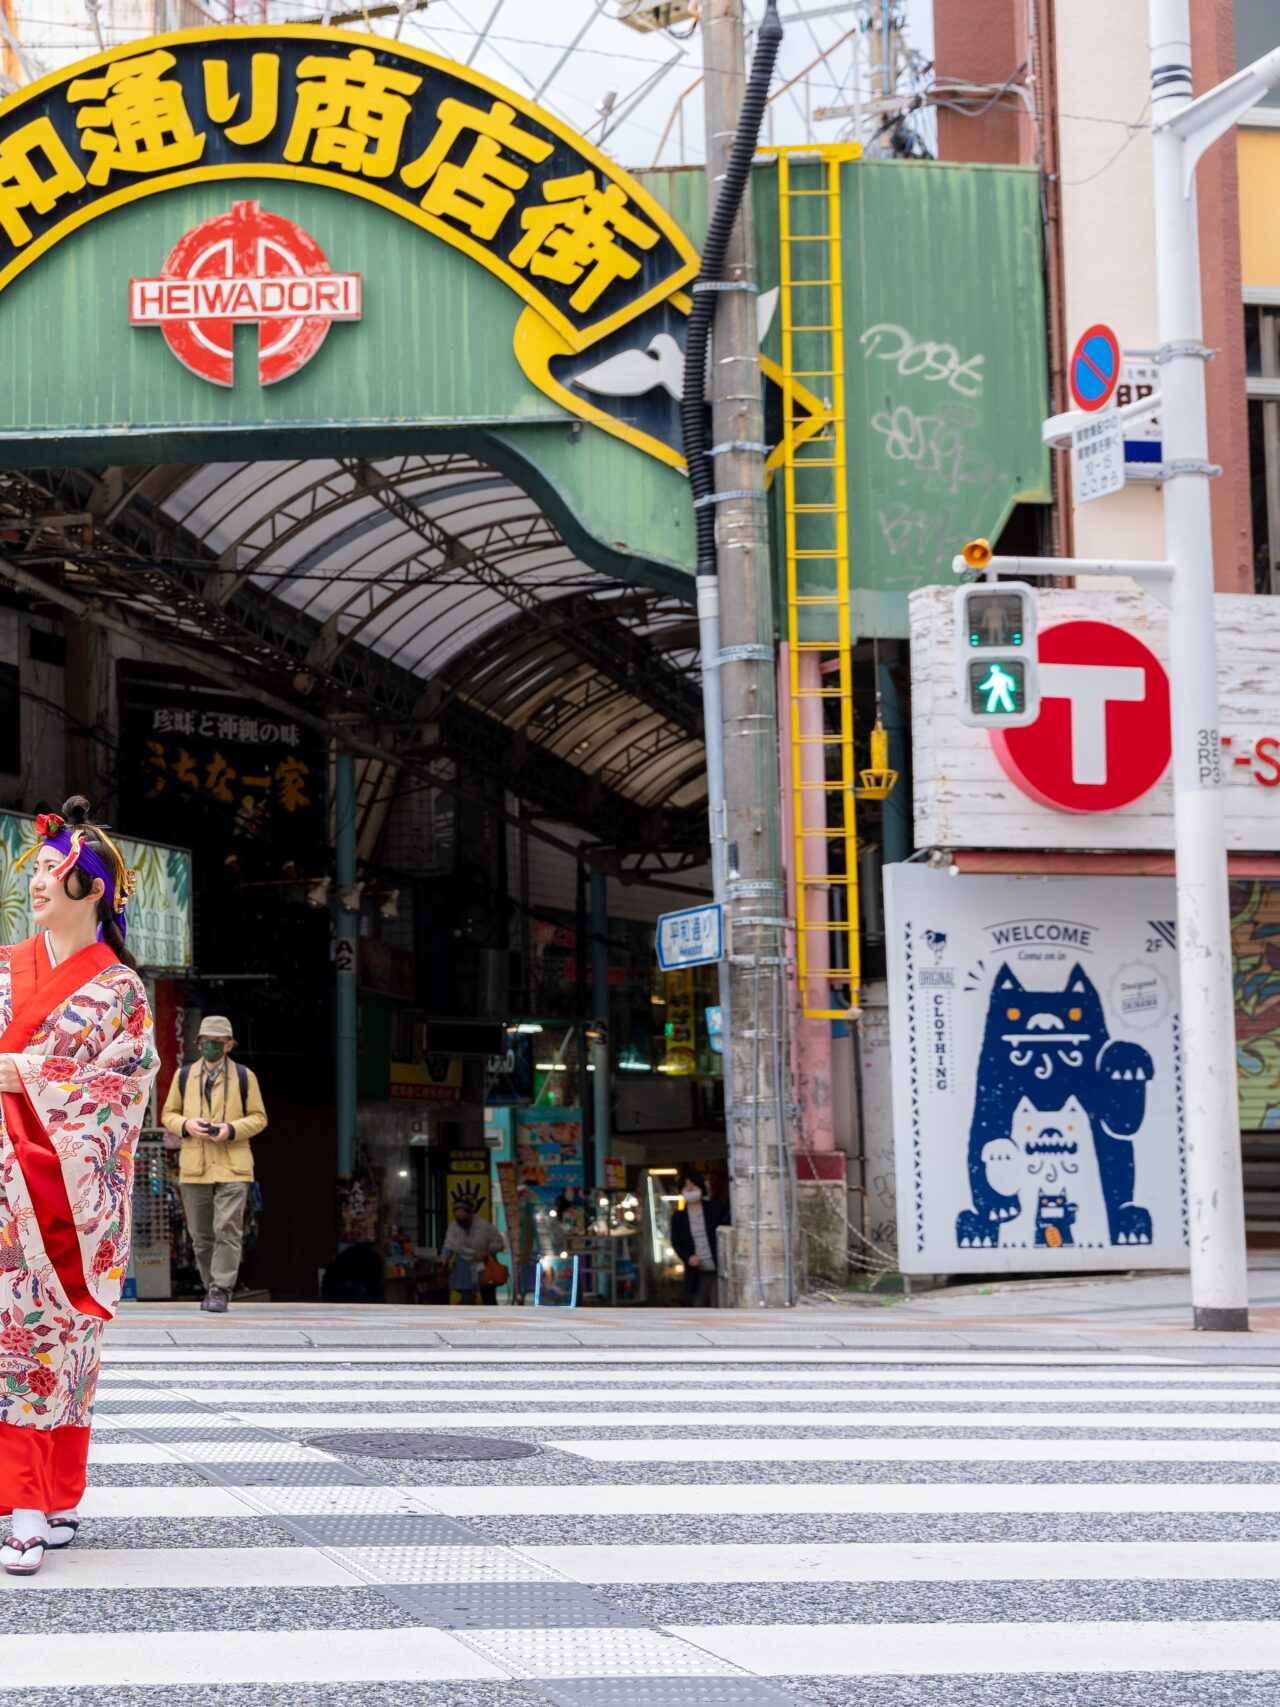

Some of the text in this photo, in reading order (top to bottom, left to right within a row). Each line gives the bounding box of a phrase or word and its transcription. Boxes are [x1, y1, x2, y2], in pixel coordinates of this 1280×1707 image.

[139, 278, 352, 321] HEIWADORI
[152, 708, 300, 747] 珍味と沖縄の味
[1033, 663, 1147, 786] T
[991, 924, 1092, 947] WELCOME
[1146, 938, 1162, 953] 2F
[1018, 950, 1043, 961] Come
[920, 969, 955, 986] ORIGINAL
[933, 994, 948, 1091] CLOTHING
